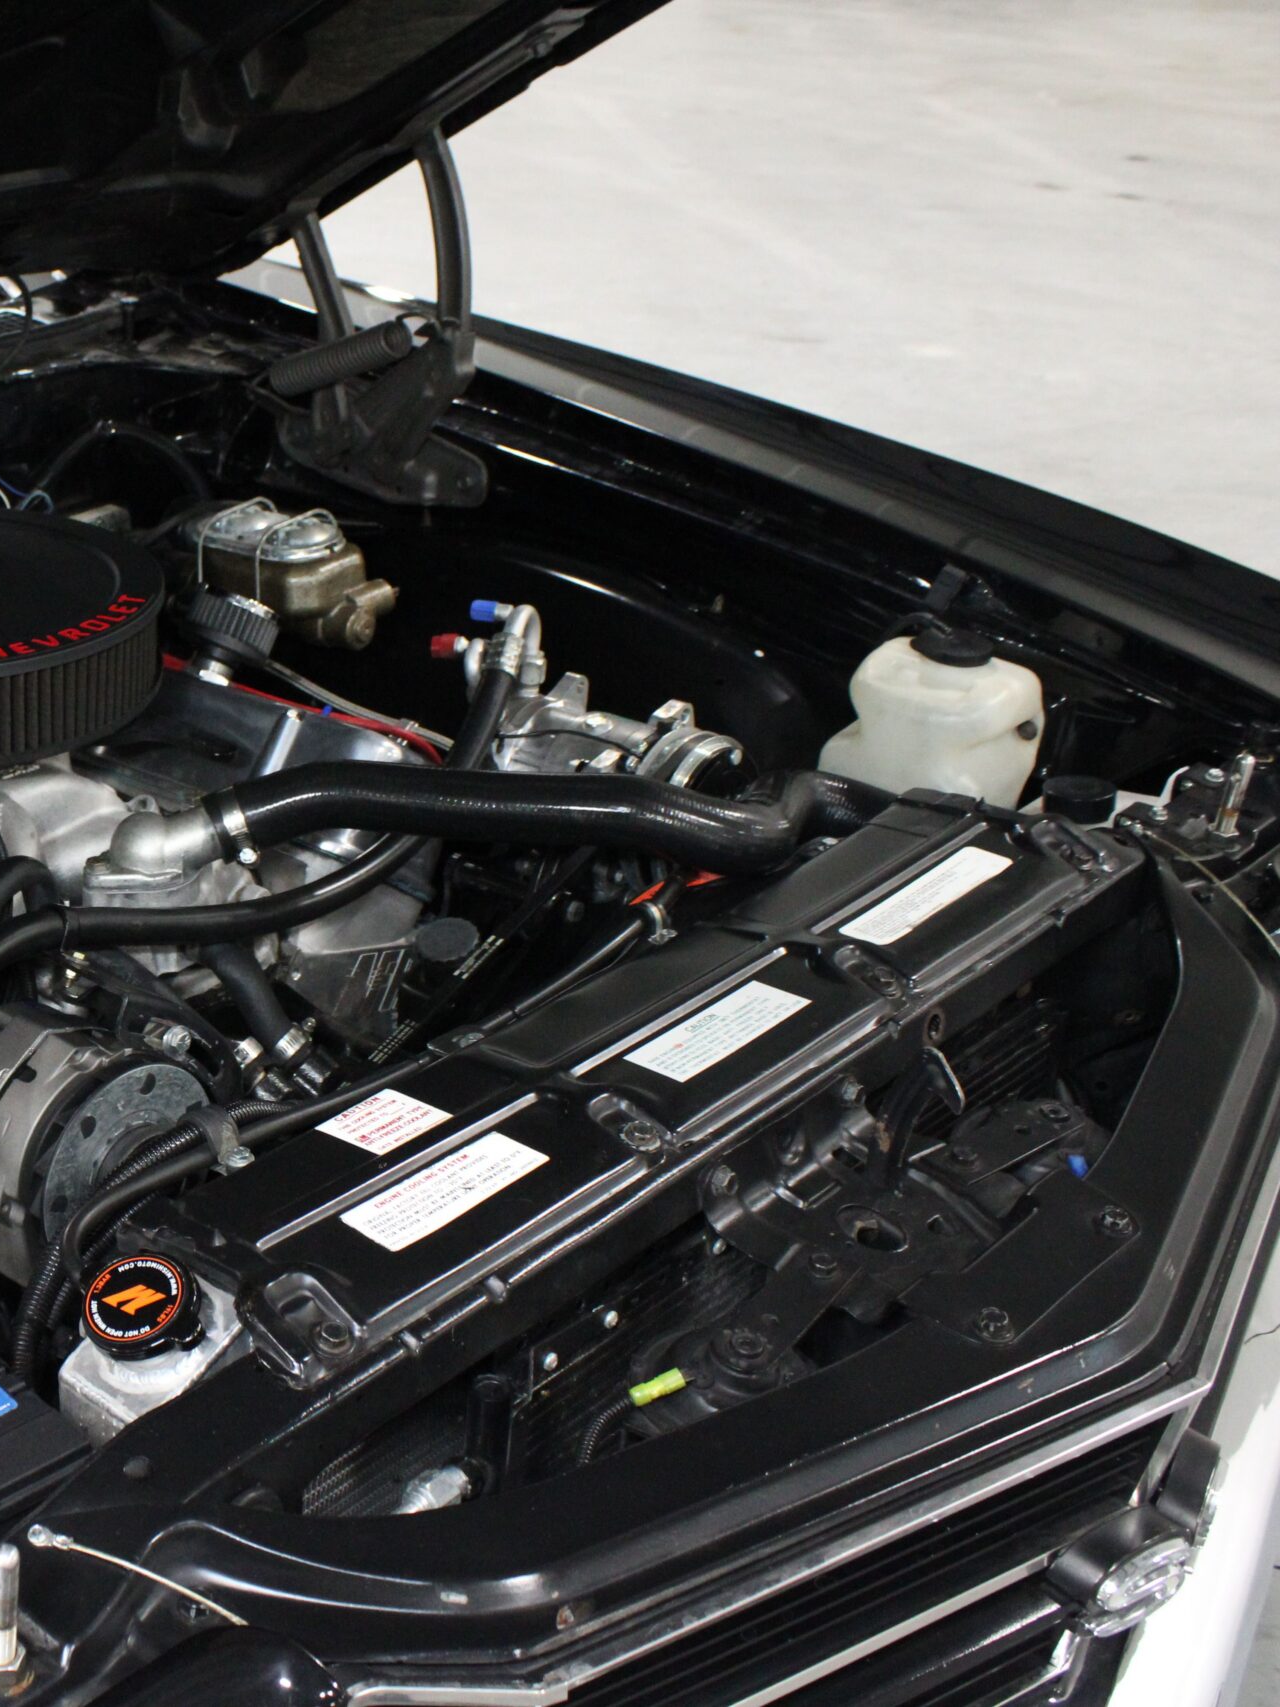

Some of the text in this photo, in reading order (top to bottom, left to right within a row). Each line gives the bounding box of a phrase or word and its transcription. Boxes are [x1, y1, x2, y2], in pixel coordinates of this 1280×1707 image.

[681, 1012, 718, 1032] CAUTION
[331, 1095, 382, 1122] CAUTION
[365, 1114, 407, 1136] PERMANENT
[405, 1105, 424, 1115] TYPE
[372, 1153, 471, 1208] ENGINE COOLING SYSTEM
[105, 1327, 123, 1337] OPEN
[124, 1330, 140, 1338] NOT
[140, 1325, 151, 1335] DO
